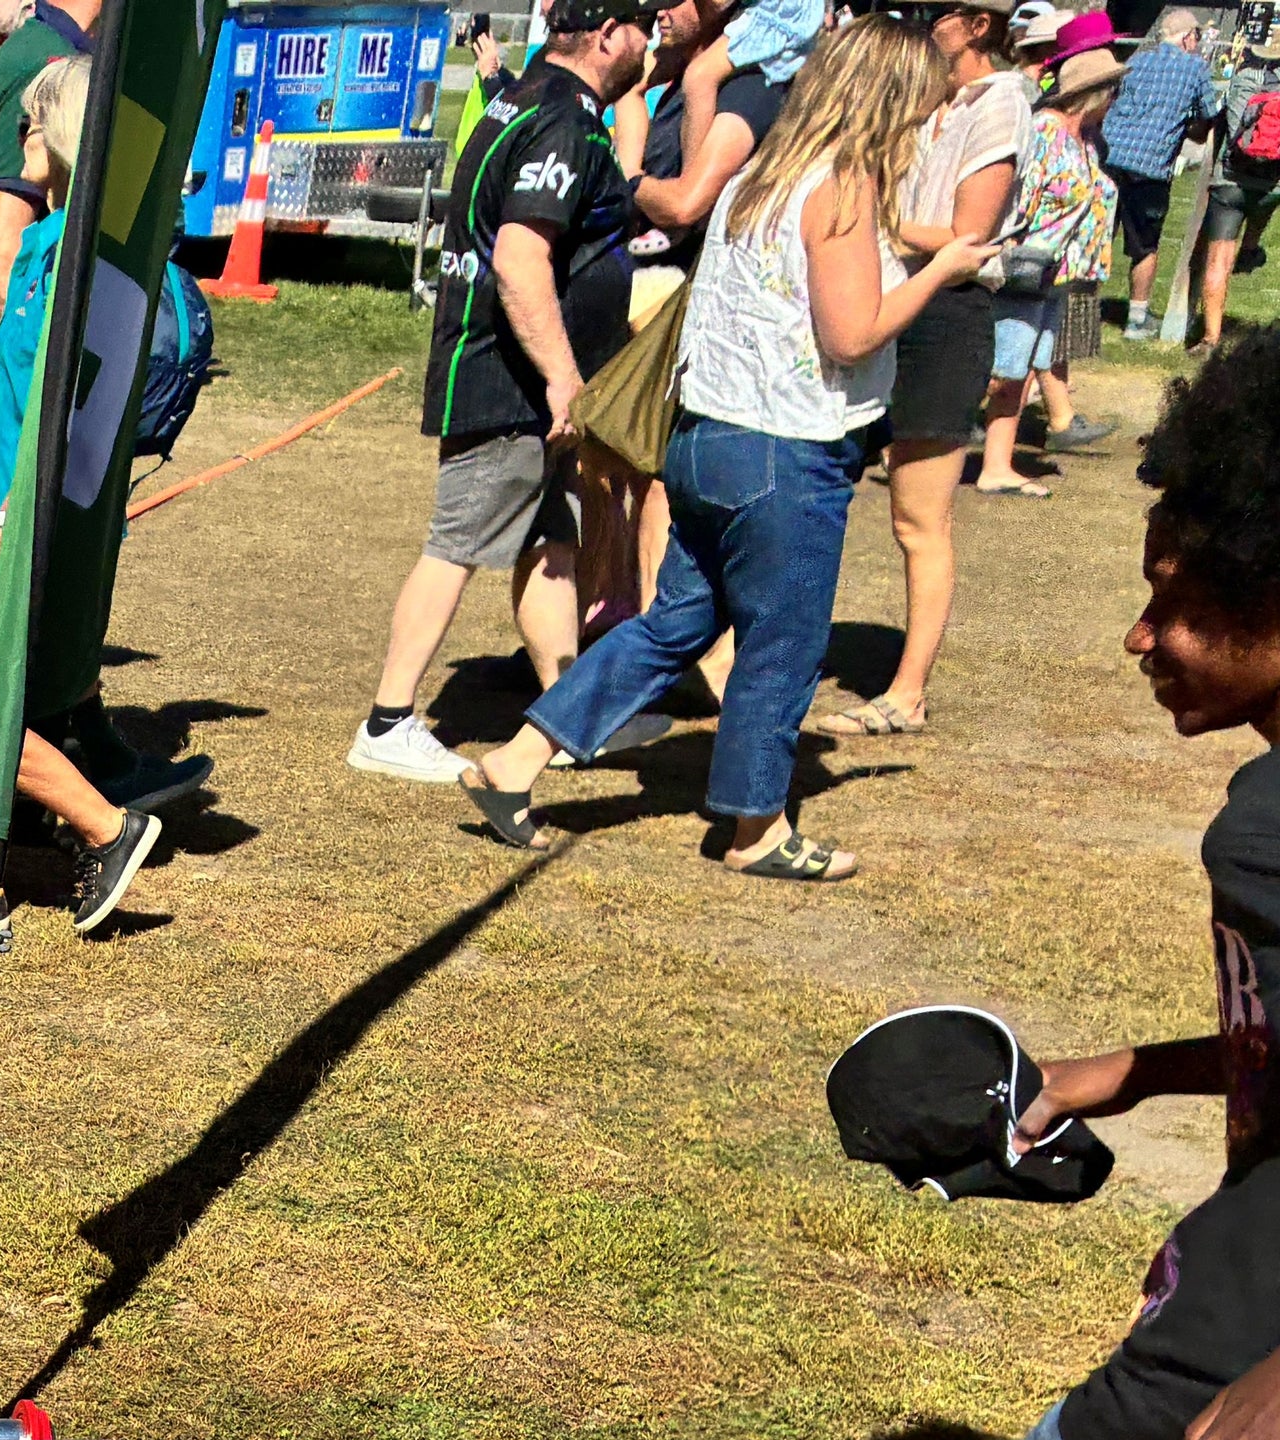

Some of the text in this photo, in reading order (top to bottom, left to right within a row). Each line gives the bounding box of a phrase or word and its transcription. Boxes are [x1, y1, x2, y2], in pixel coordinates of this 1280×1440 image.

[275, 34, 330, 78] HIRE
[356, 33, 392, 77] ME
[514, 152, 577, 200] sky
